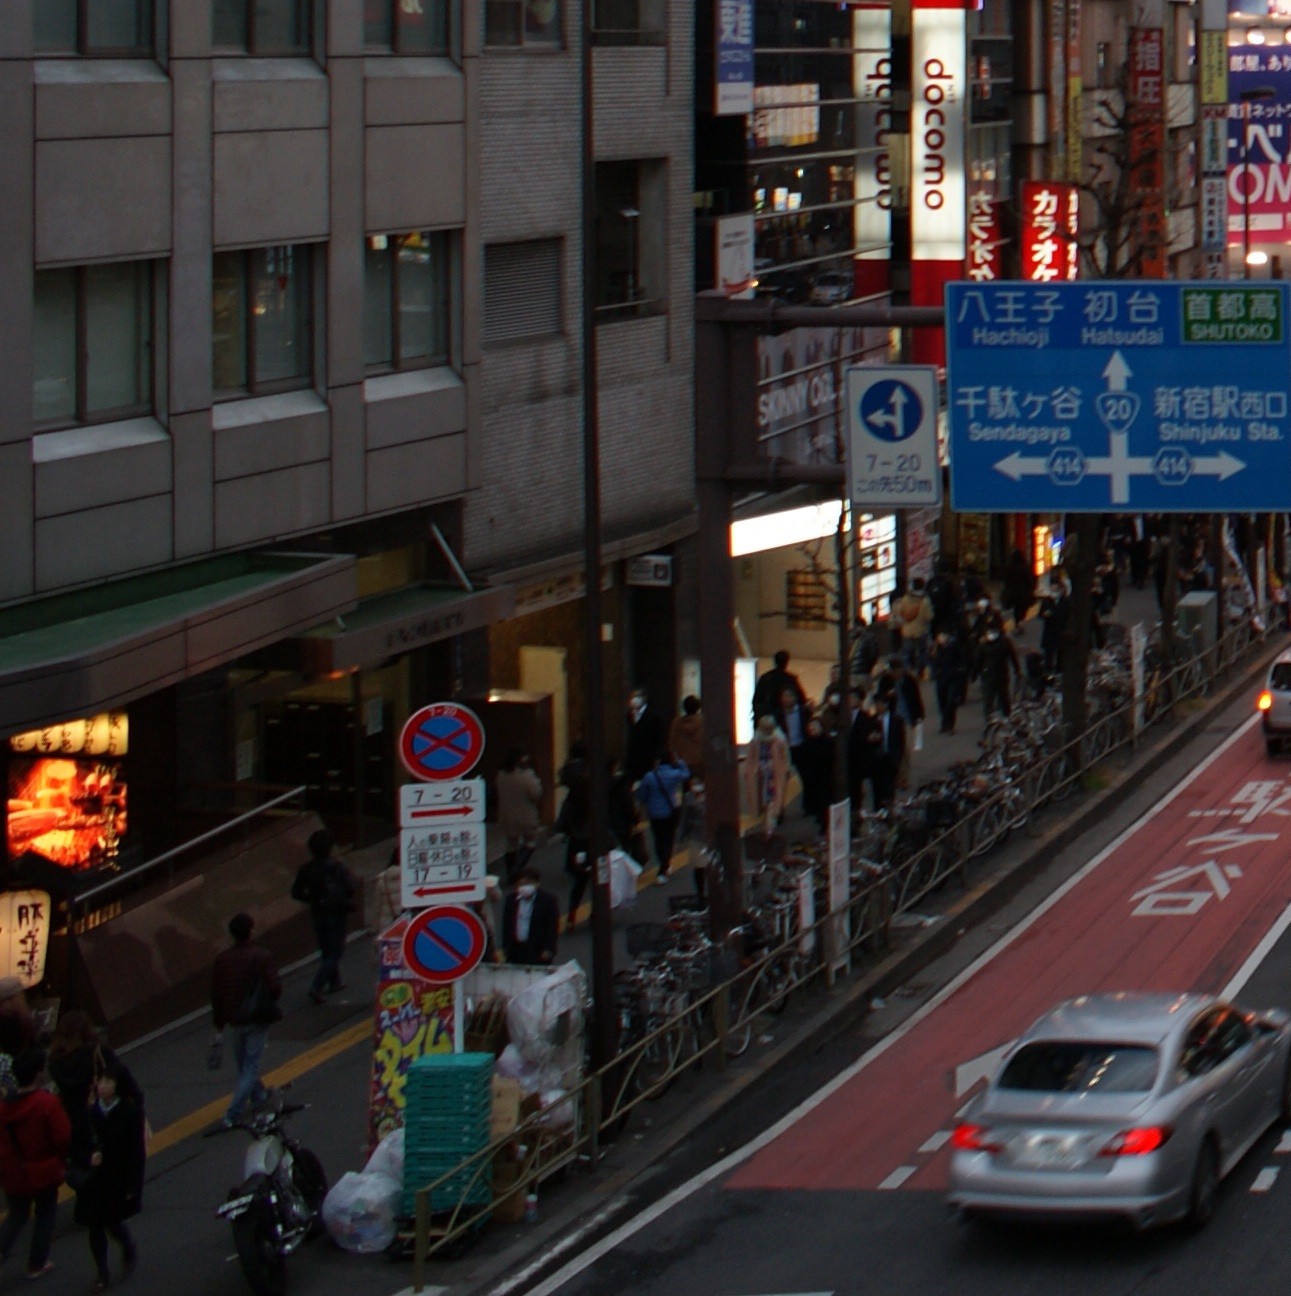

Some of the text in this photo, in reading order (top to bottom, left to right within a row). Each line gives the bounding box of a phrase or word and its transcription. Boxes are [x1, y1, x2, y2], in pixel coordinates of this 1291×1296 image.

[924, 57, 955, 212] docomo
[1030, 188, 1060, 281] カラオケ
[956, 290, 1279, 323] 八王子 初台 首都高
[972, 323, 1274, 349] Hachioji Hatsudai SHUTOKO
[1105, 399, 1131, 421] 20
[1154, 386, 1288, 420] 新宿駅西口
[968, 422, 1284, 445] Sendagaya Shinjuku Sta.
[867, 454, 922, 472] 7-20
[1051, 456, 1189, 477] 414 414
